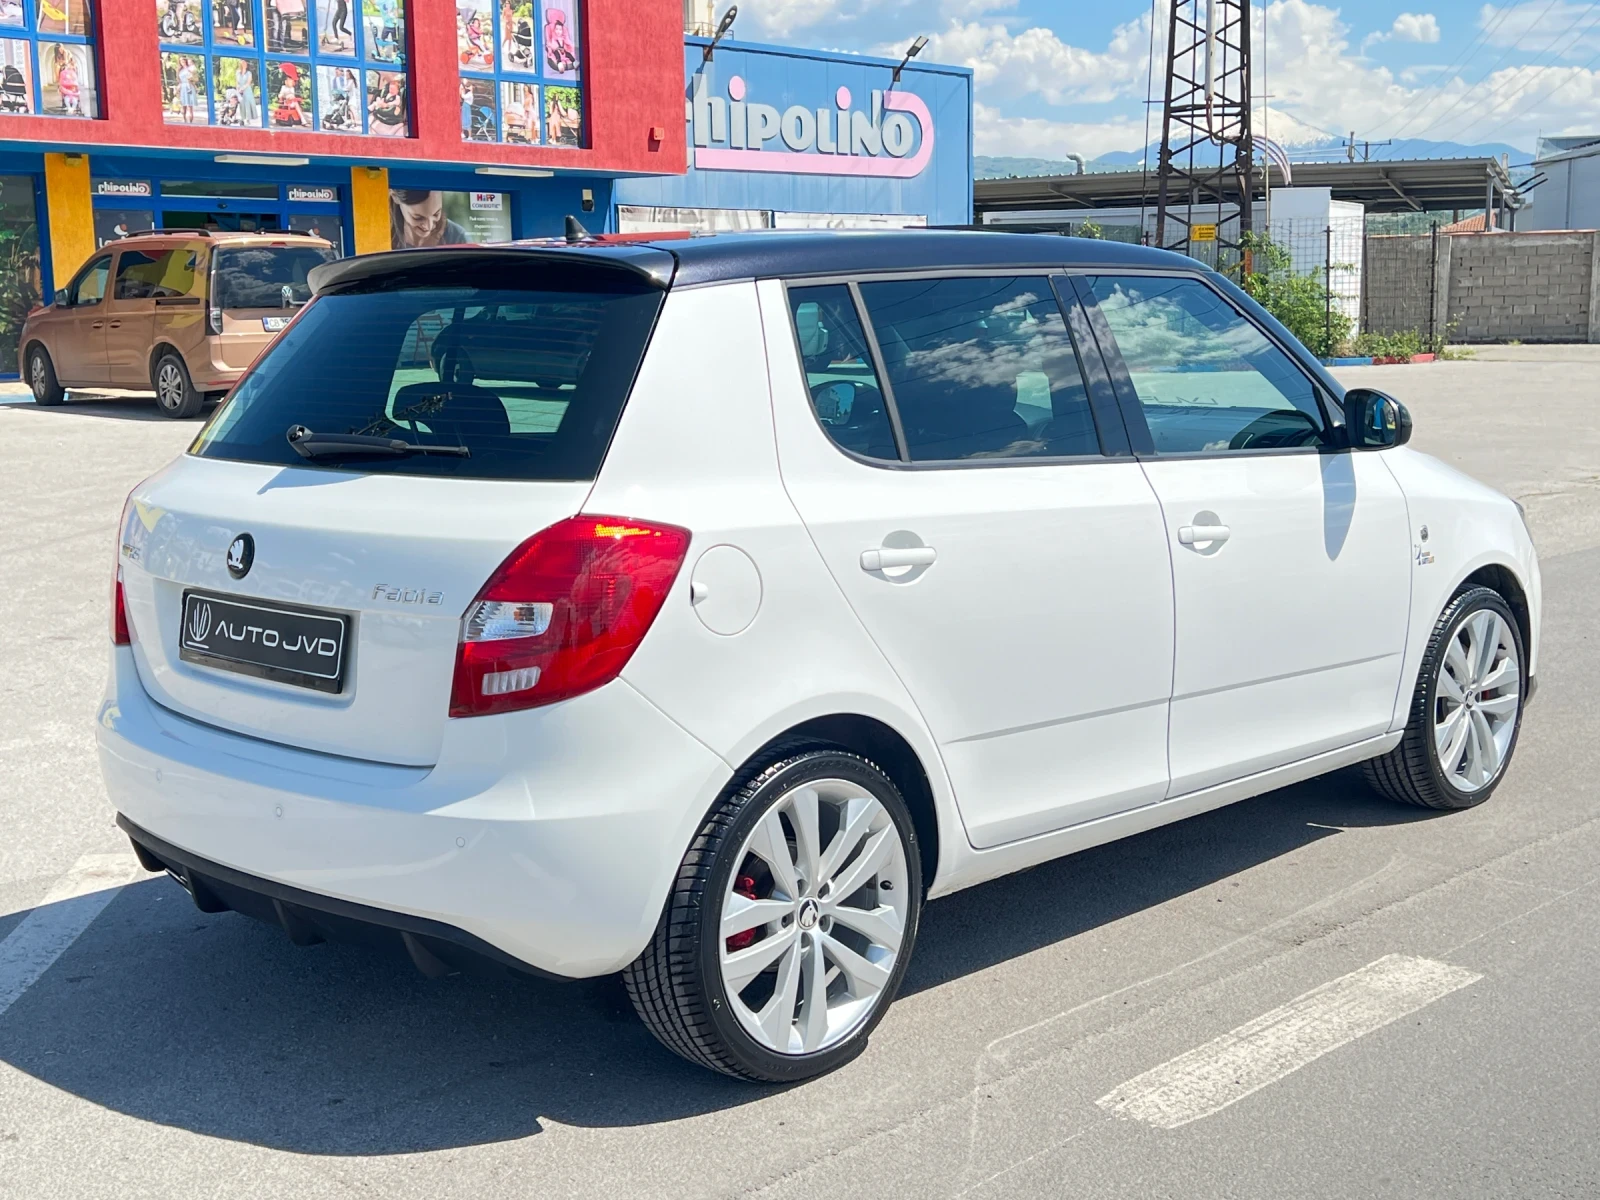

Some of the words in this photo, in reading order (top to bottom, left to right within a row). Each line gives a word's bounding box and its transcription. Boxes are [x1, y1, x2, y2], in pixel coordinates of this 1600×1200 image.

[372, 583, 445, 605] Fabia
[215, 620, 279, 647] AUTO
[283, 635, 337, 656] JVD
